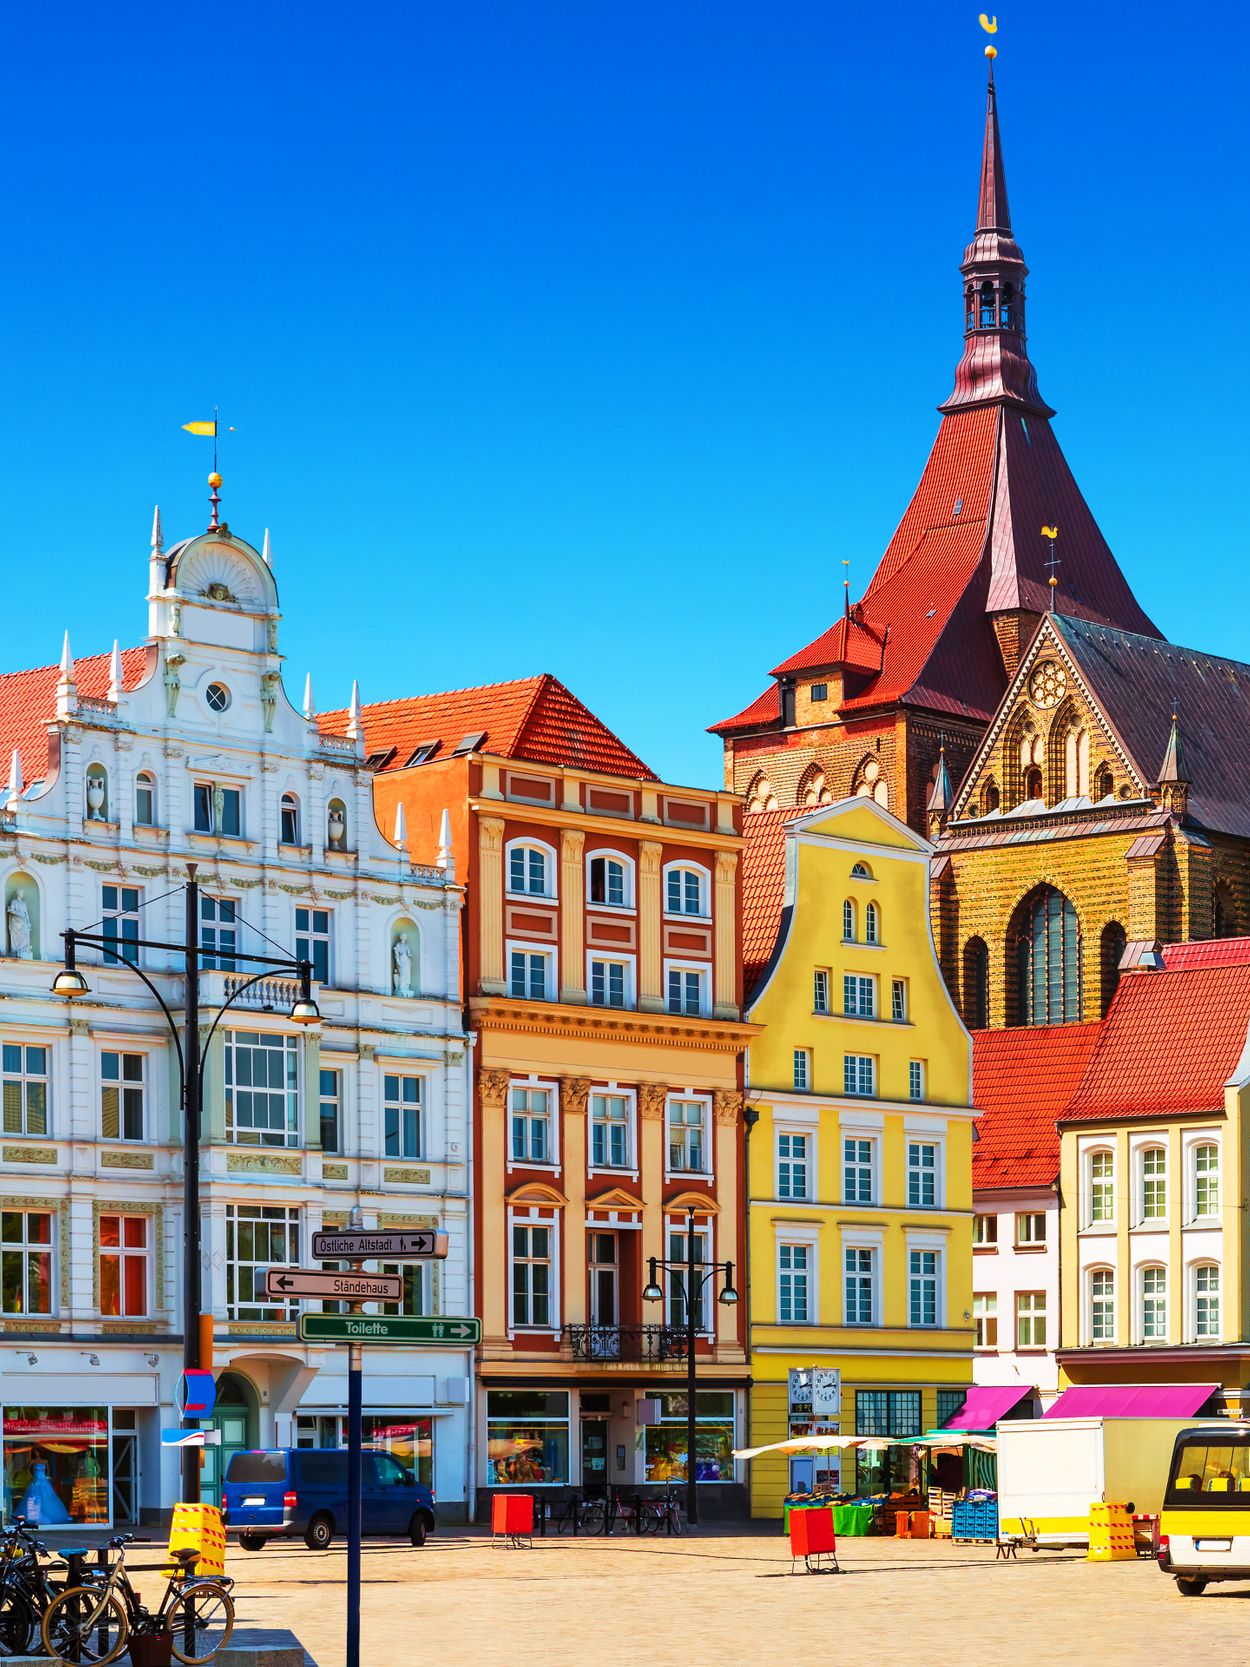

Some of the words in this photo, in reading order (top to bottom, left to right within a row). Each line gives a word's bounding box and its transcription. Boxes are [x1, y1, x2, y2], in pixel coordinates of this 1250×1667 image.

[320, 1238, 354, 1252] Östliche
[358, 1239, 393, 1251] Altstadt
[333, 1280, 389, 1294] Ständehaus
[345, 1322, 389, 1335] Toilette
